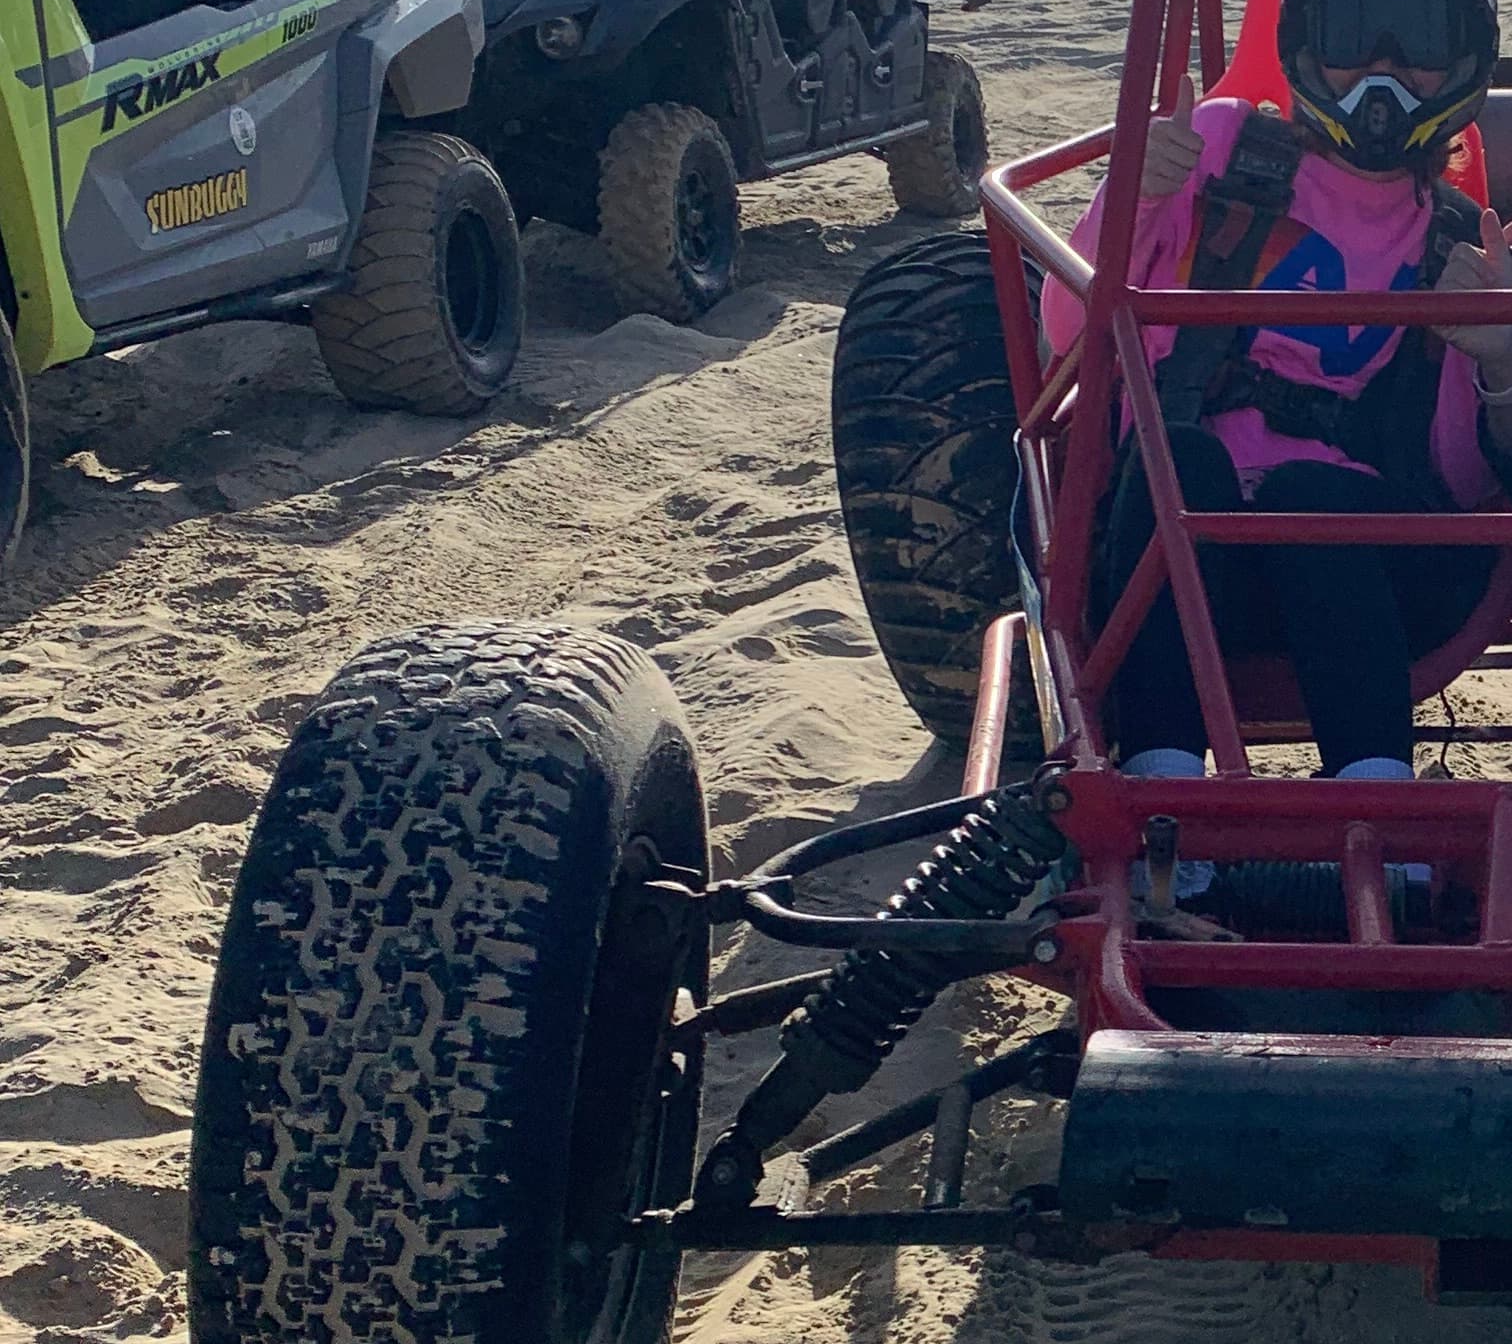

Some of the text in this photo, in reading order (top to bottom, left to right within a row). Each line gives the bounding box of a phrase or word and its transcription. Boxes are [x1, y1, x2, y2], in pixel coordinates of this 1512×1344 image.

[282, 9, 317, 43] 1000
[100, 48, 222, 135] RMAX
[145, 166, 248, 235] SUNBUGGY
